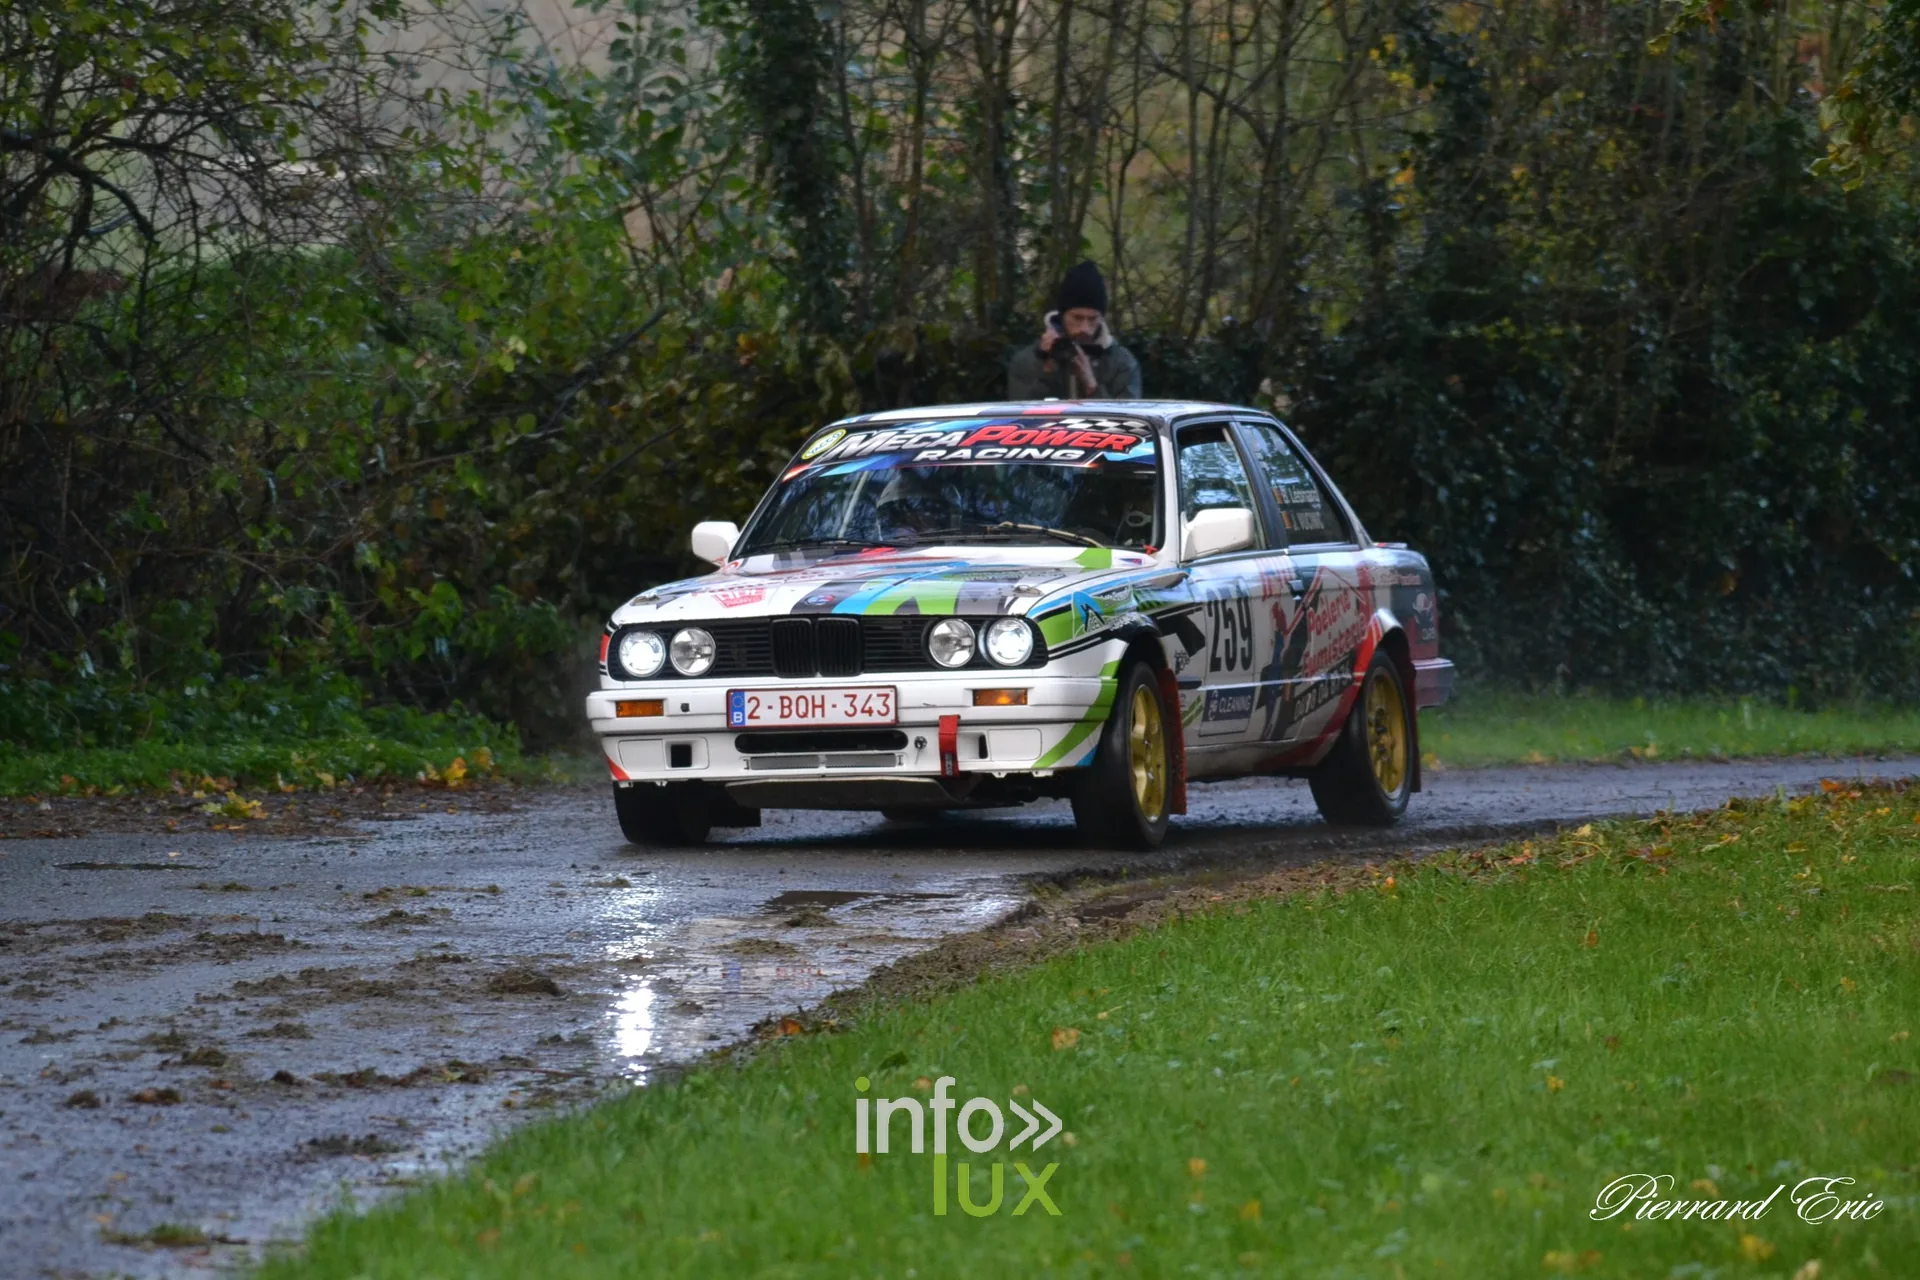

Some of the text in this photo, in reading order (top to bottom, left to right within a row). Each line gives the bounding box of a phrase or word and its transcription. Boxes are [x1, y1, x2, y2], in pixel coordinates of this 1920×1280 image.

[913, 448, 1086, 462] RACING
[1206, 586, 1253, 673] 259
[733, 712, 743, 723] B
